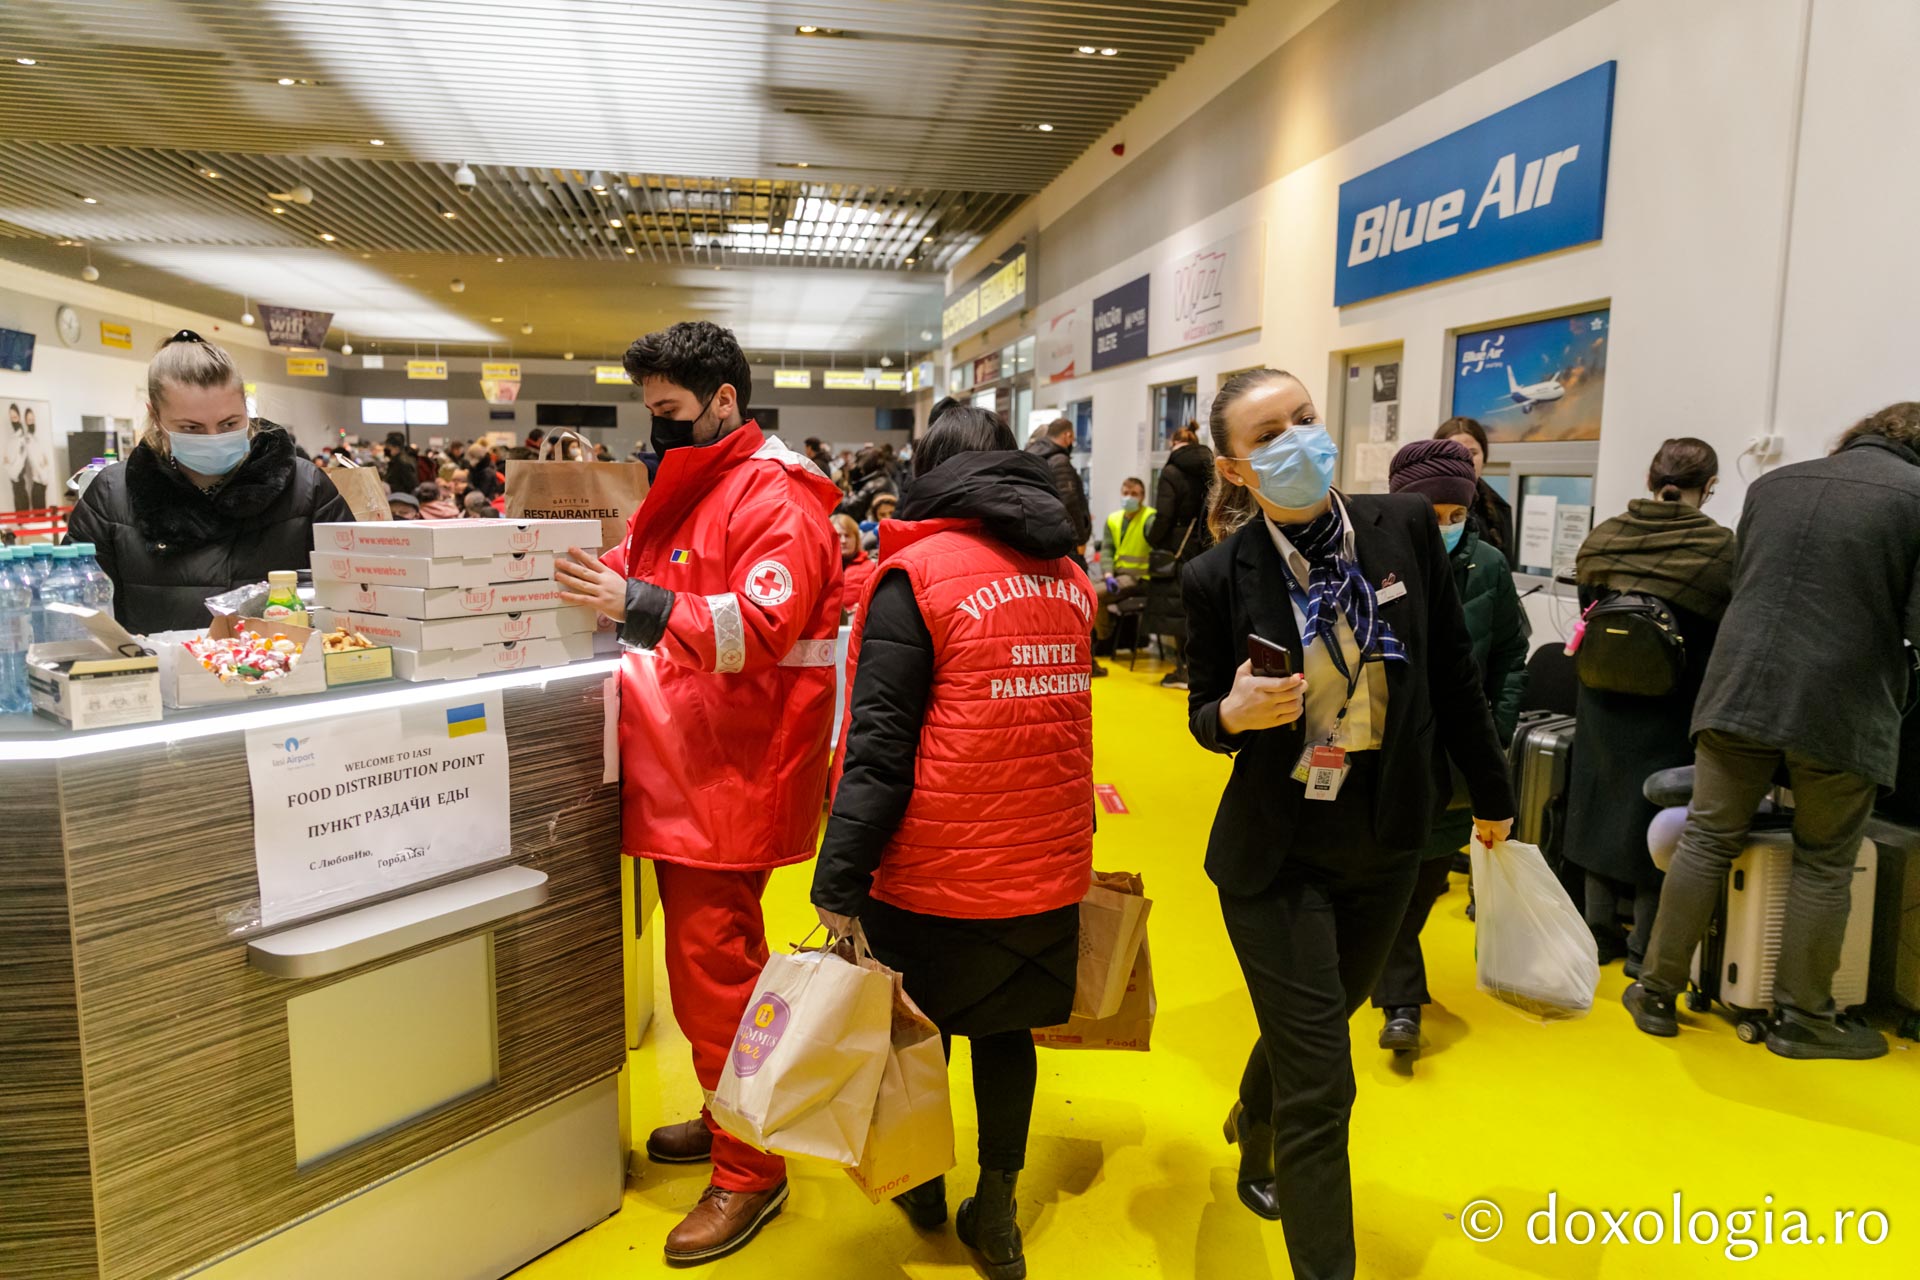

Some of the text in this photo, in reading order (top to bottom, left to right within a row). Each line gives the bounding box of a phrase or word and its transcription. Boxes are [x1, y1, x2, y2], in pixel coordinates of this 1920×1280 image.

[1347, 144, 1580, 268] Blue Air
[270, 316, 304, 332] wifi
[1462, 348, 1504, 363] Blue Air
[523, 508, 619, 519] RESTAURANTELE
[1011, 643, 1077, 665] SFINTEI
[991, 672, 1090, 699] PARASCHEVA
[287, 752, 315, 764] Airport
[345, 748, 432, 773] WELCOME TO IASI
[287, 753, 485, 808] FOOD DISTRIBUTION POINT
[308, 814, 361, 838] ПУНКТ
[437, 787, 469, 806] ЕДЫ
[874, 1173, 910, 1195] more
